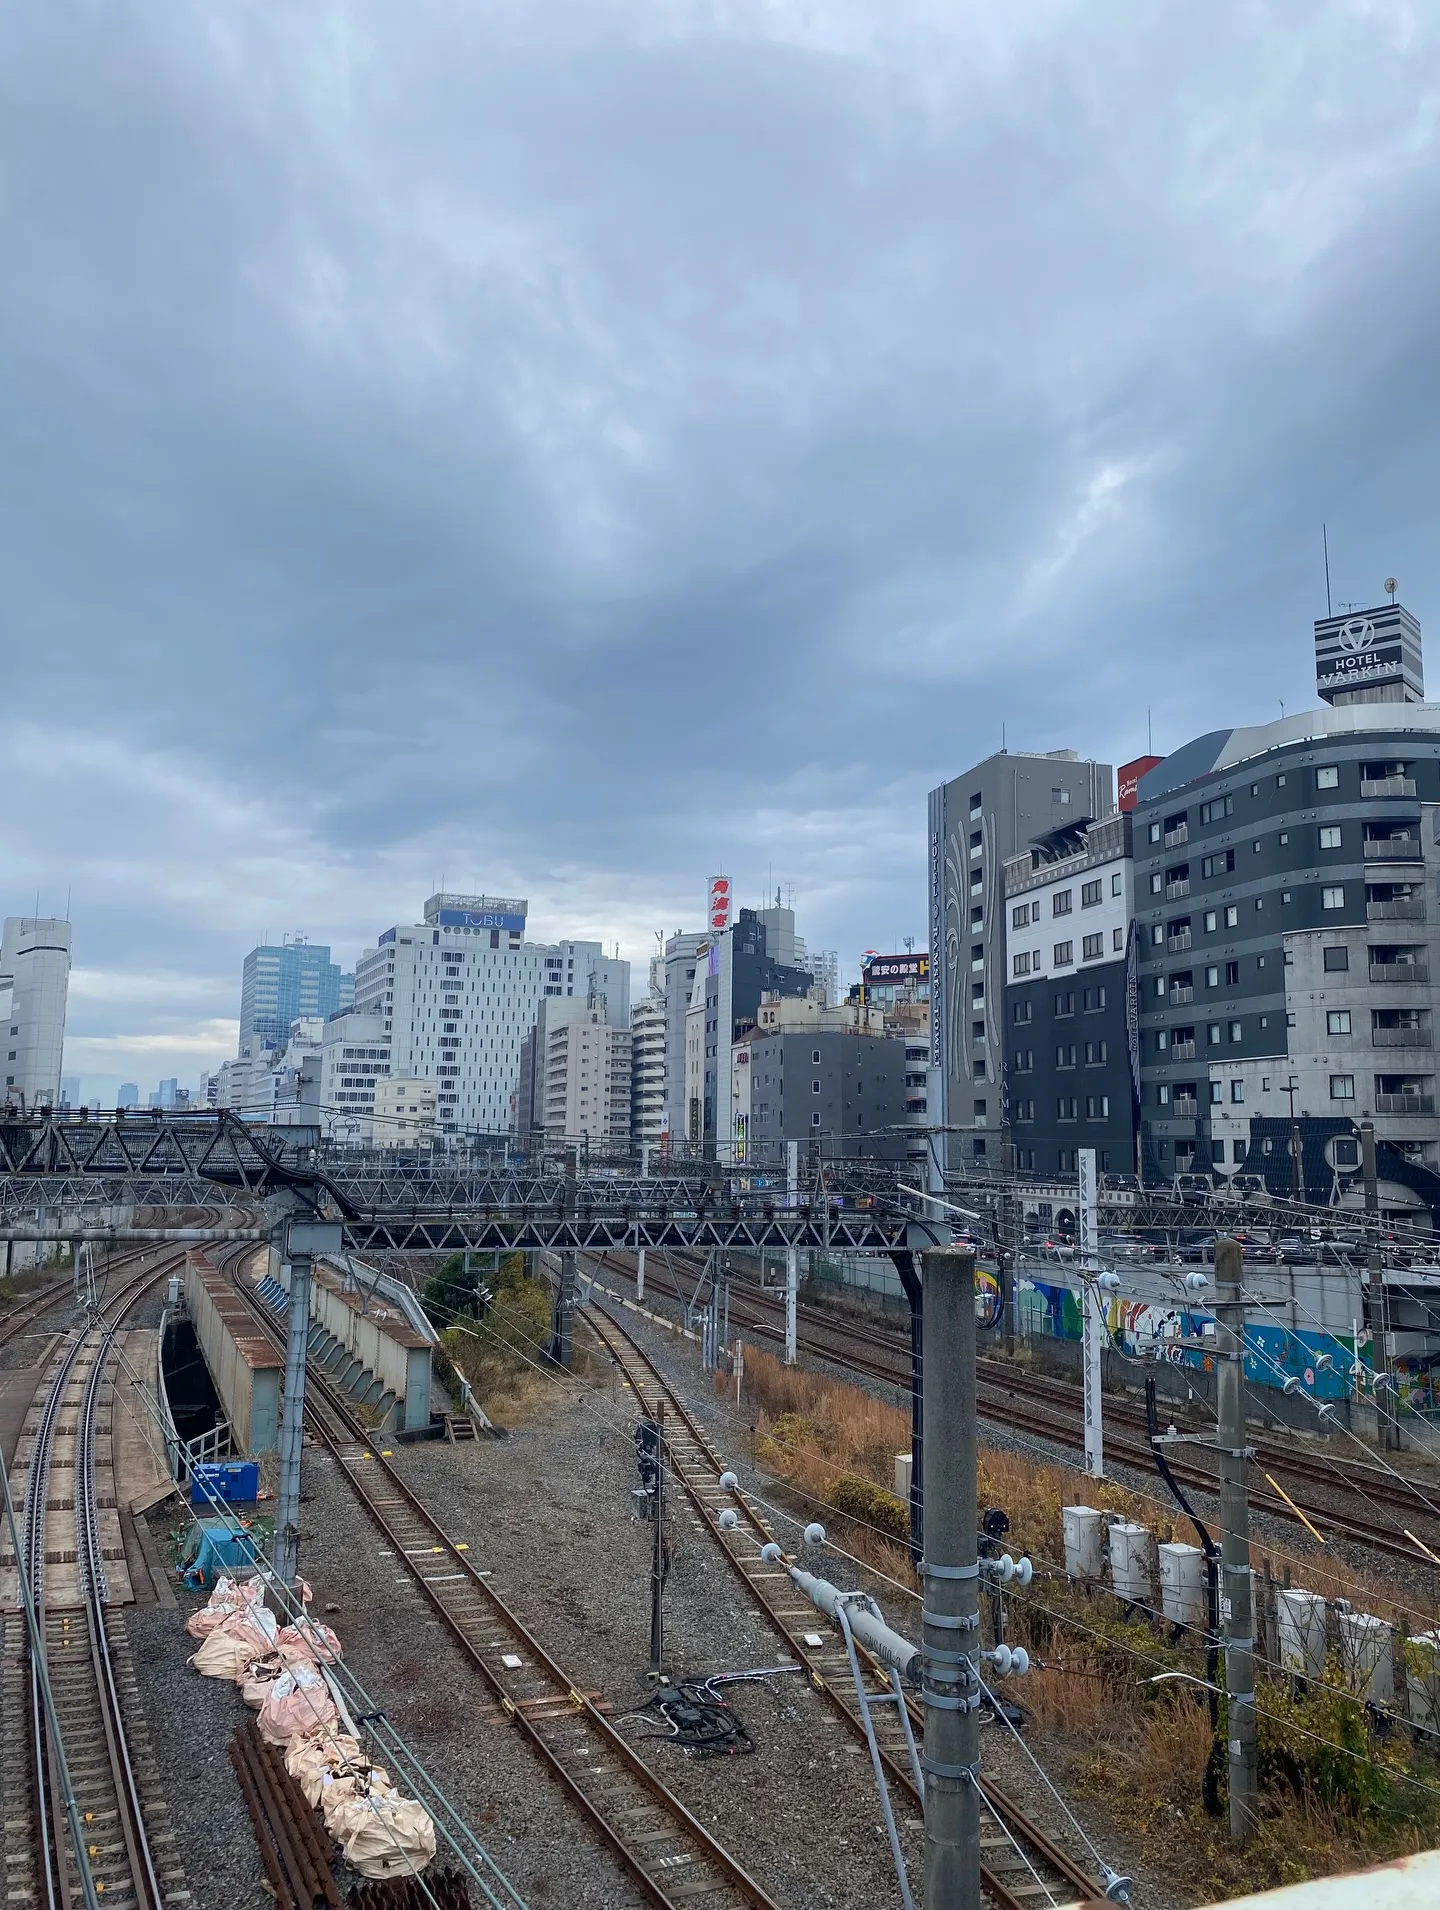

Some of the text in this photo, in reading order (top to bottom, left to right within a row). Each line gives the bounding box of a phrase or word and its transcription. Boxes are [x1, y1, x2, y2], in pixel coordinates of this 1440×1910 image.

[1320, 660, 1398, 686] VARKIN
[1335, 653, 1381, 670] HOTEL
[931, 831, 939, 897] HOTEL
[462, 913, 504, 927] TOBU
[932, 926, 941, 999] RAMSES
[1129, 975, 1138, 1025] VARKIN
